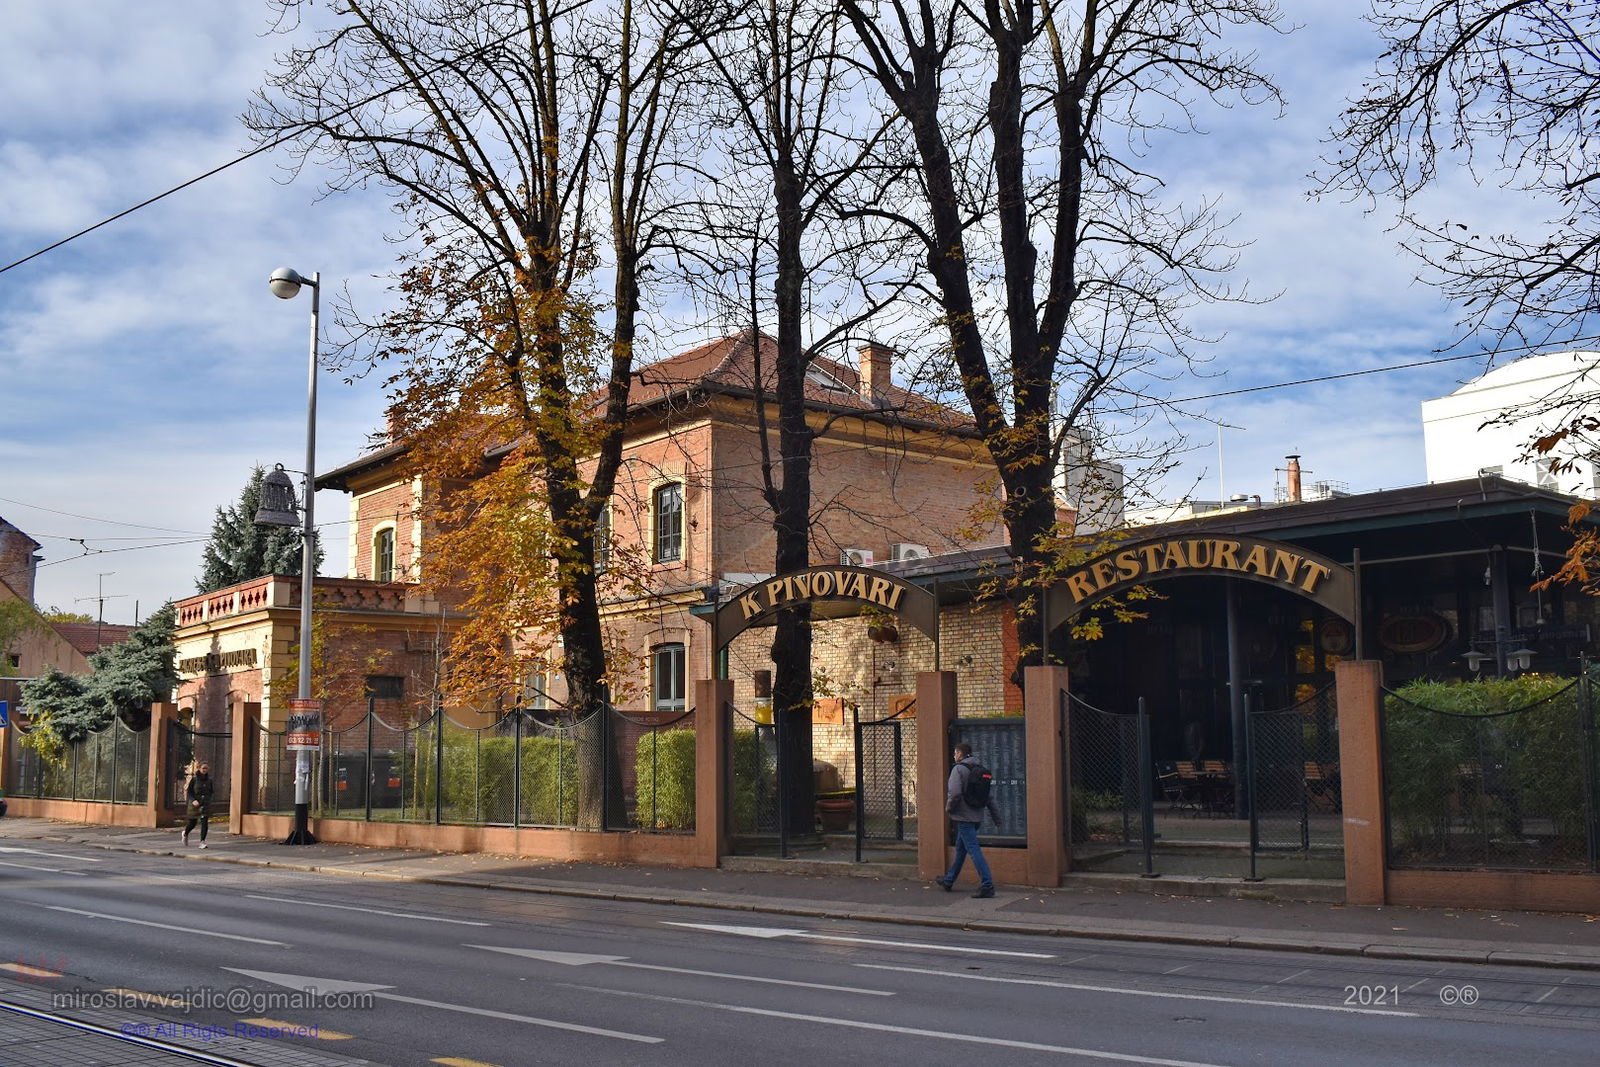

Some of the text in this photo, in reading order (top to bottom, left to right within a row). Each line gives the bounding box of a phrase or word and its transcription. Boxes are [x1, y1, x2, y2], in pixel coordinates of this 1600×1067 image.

[739, 571, 906, 620] K PIVOVARI
[1065, 539, 1331, 603] RESTAURANT
